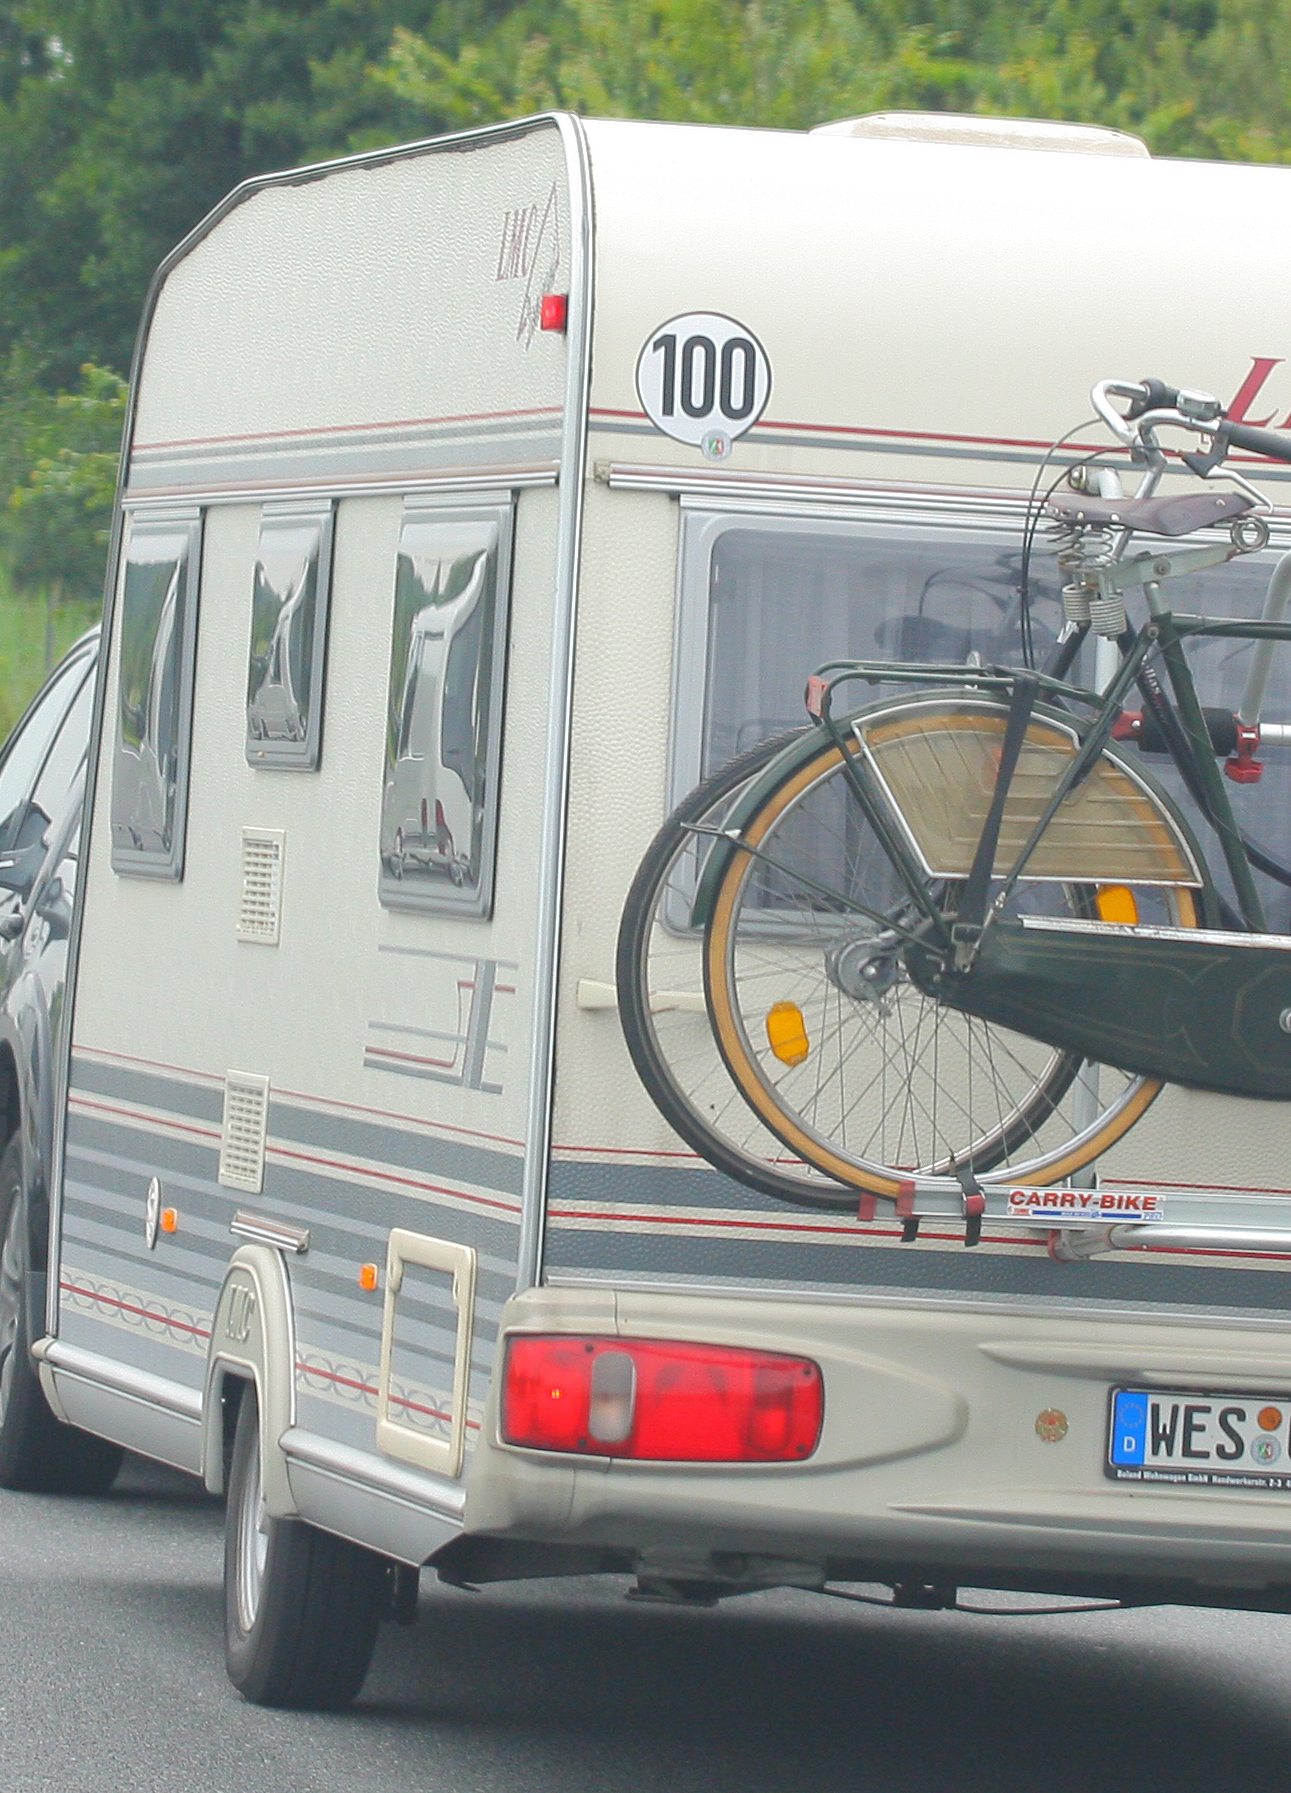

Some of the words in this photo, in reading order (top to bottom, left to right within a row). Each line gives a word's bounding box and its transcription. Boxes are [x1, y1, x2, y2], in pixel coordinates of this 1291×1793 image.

[652, 333, 757, 421] 100
[1009, 1190, 1158, 1211] CARRY-BIKE
[1122, 1435, 1136, 1452] D
[1150, 1402, 1247, 1462] WES
